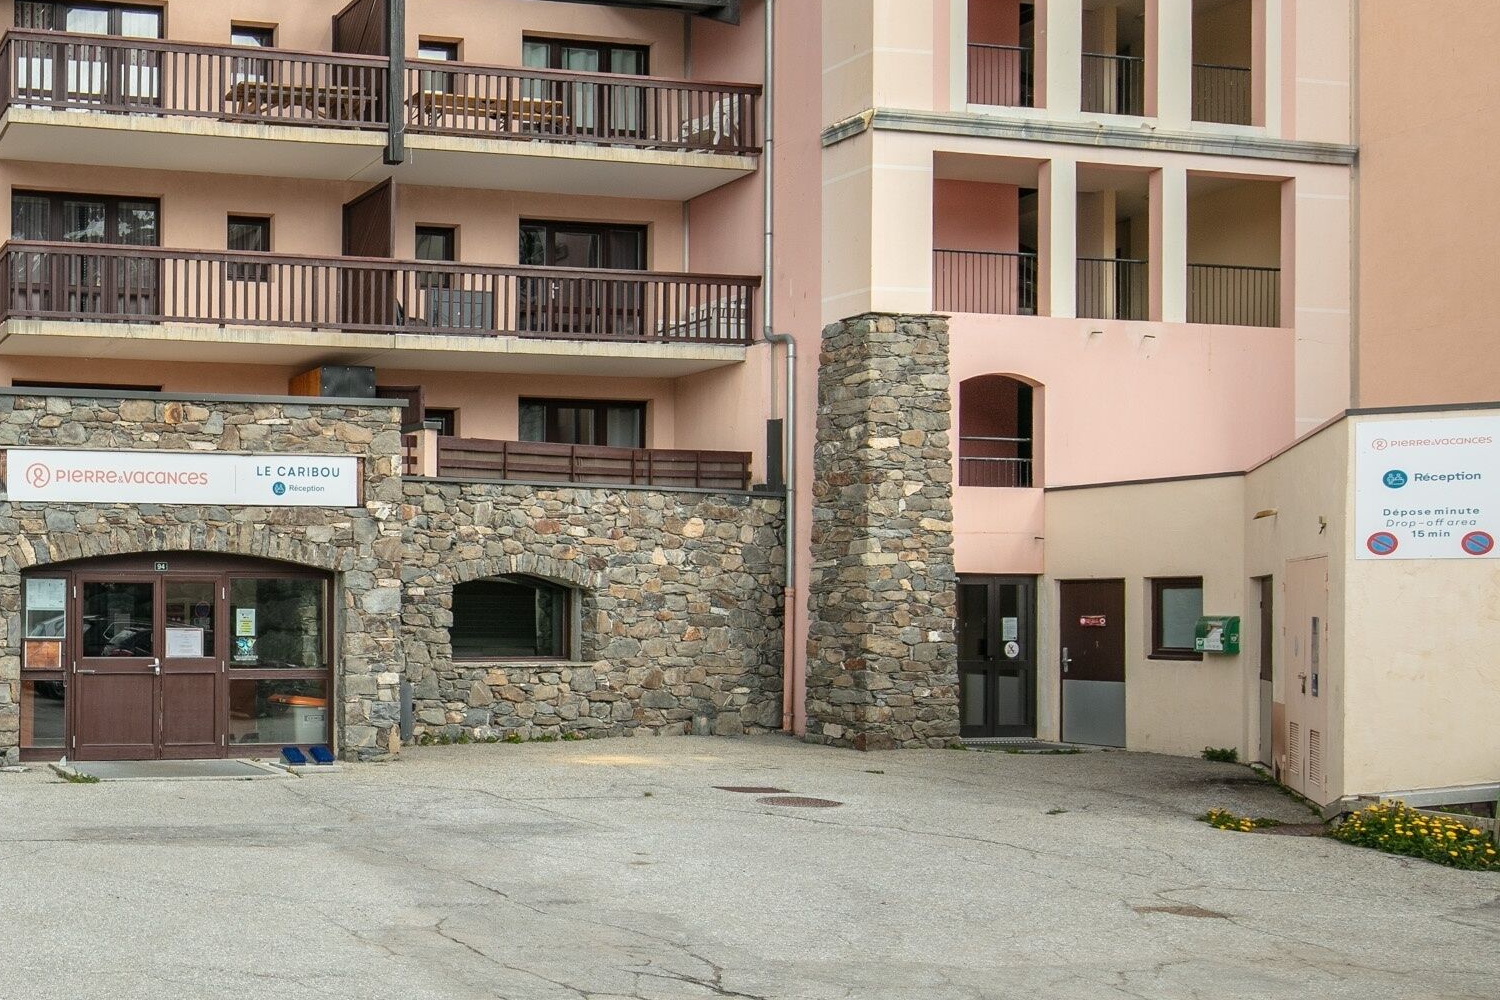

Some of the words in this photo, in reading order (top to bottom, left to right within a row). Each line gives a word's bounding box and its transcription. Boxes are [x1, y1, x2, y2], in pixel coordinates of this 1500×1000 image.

[256, 466, 271, 476] LE
[277, 466, 340, 477] CARIBOU
[1414, 471, 1481, 483] Réception
[289, 484, 325, 493] Réception
[1383, 508, 1431, 517] Dépose
[1434, 507, 1480, 515] minute
[1412, 530, 1425, 538] 15
[1428, 530, 1450, 538] min
